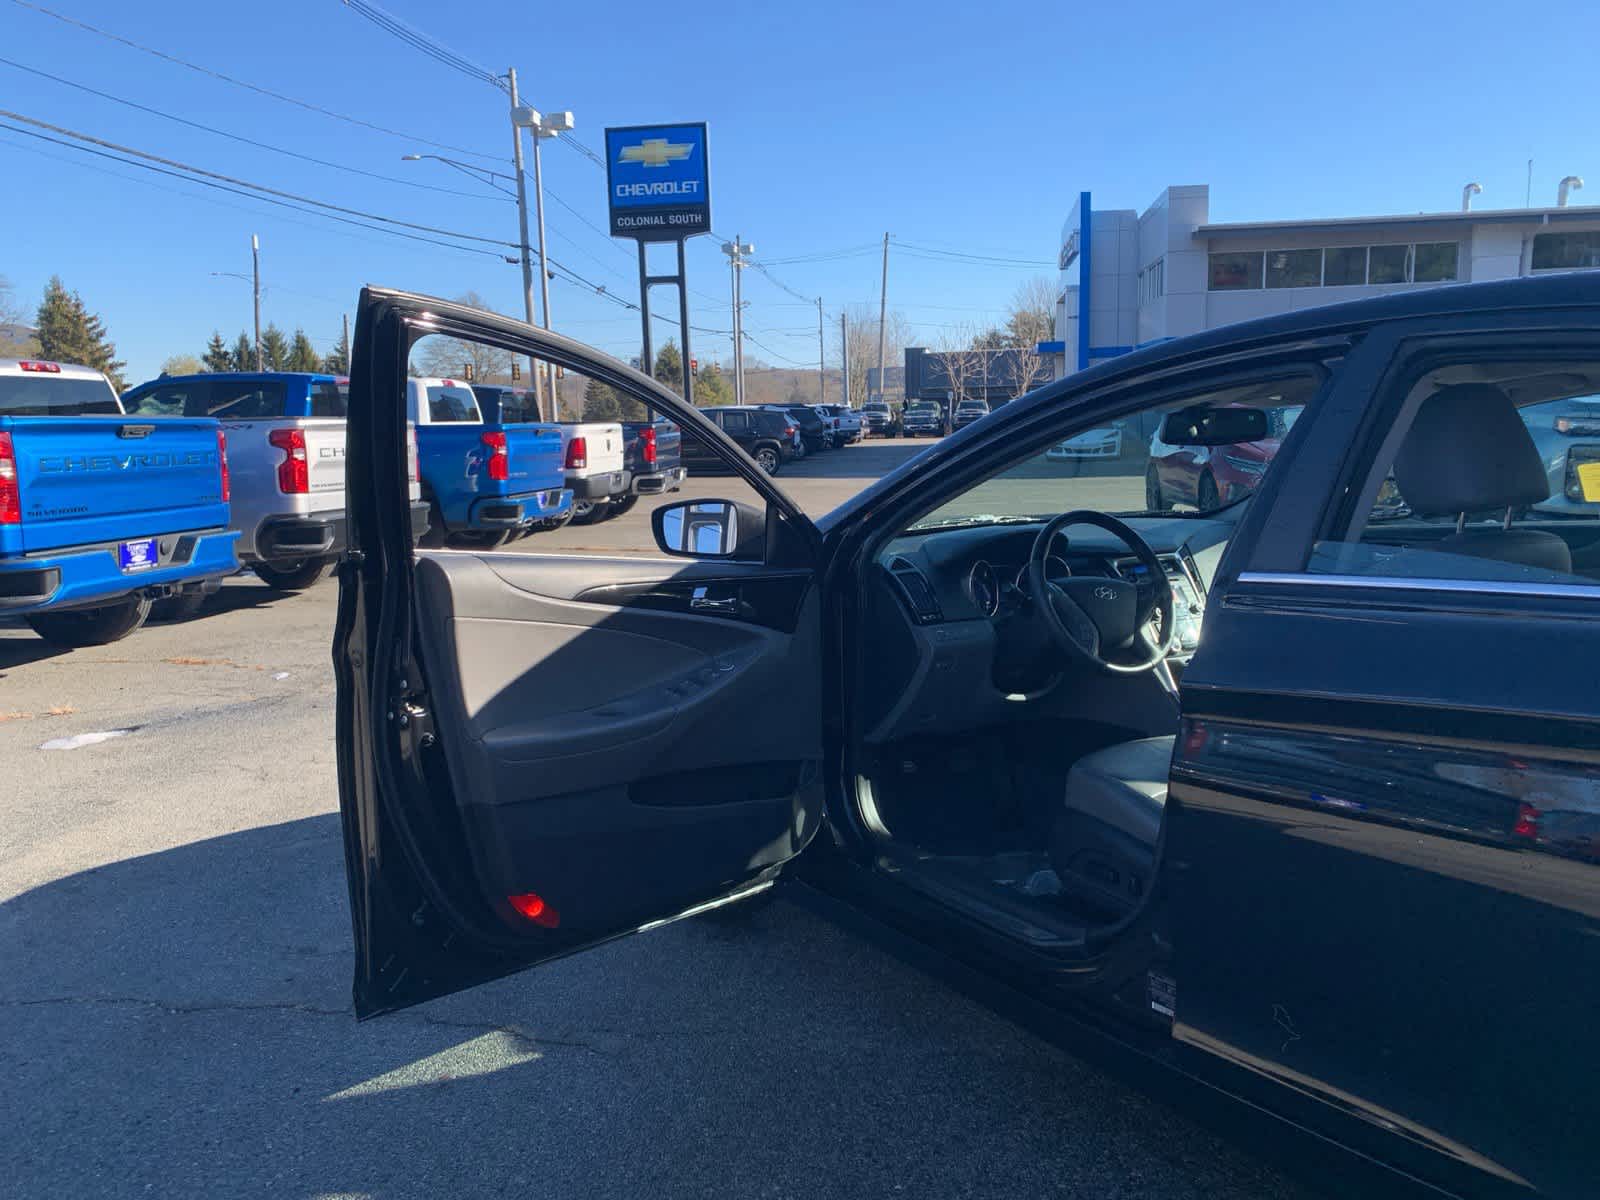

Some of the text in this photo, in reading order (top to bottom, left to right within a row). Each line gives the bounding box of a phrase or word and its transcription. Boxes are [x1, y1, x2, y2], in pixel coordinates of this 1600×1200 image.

[616, 181, 699, 197] CHEVROLET
[617, 213, 703, 227] COLONIAL SOUTH
[39, 453, 217, 473] CHEVROLET
